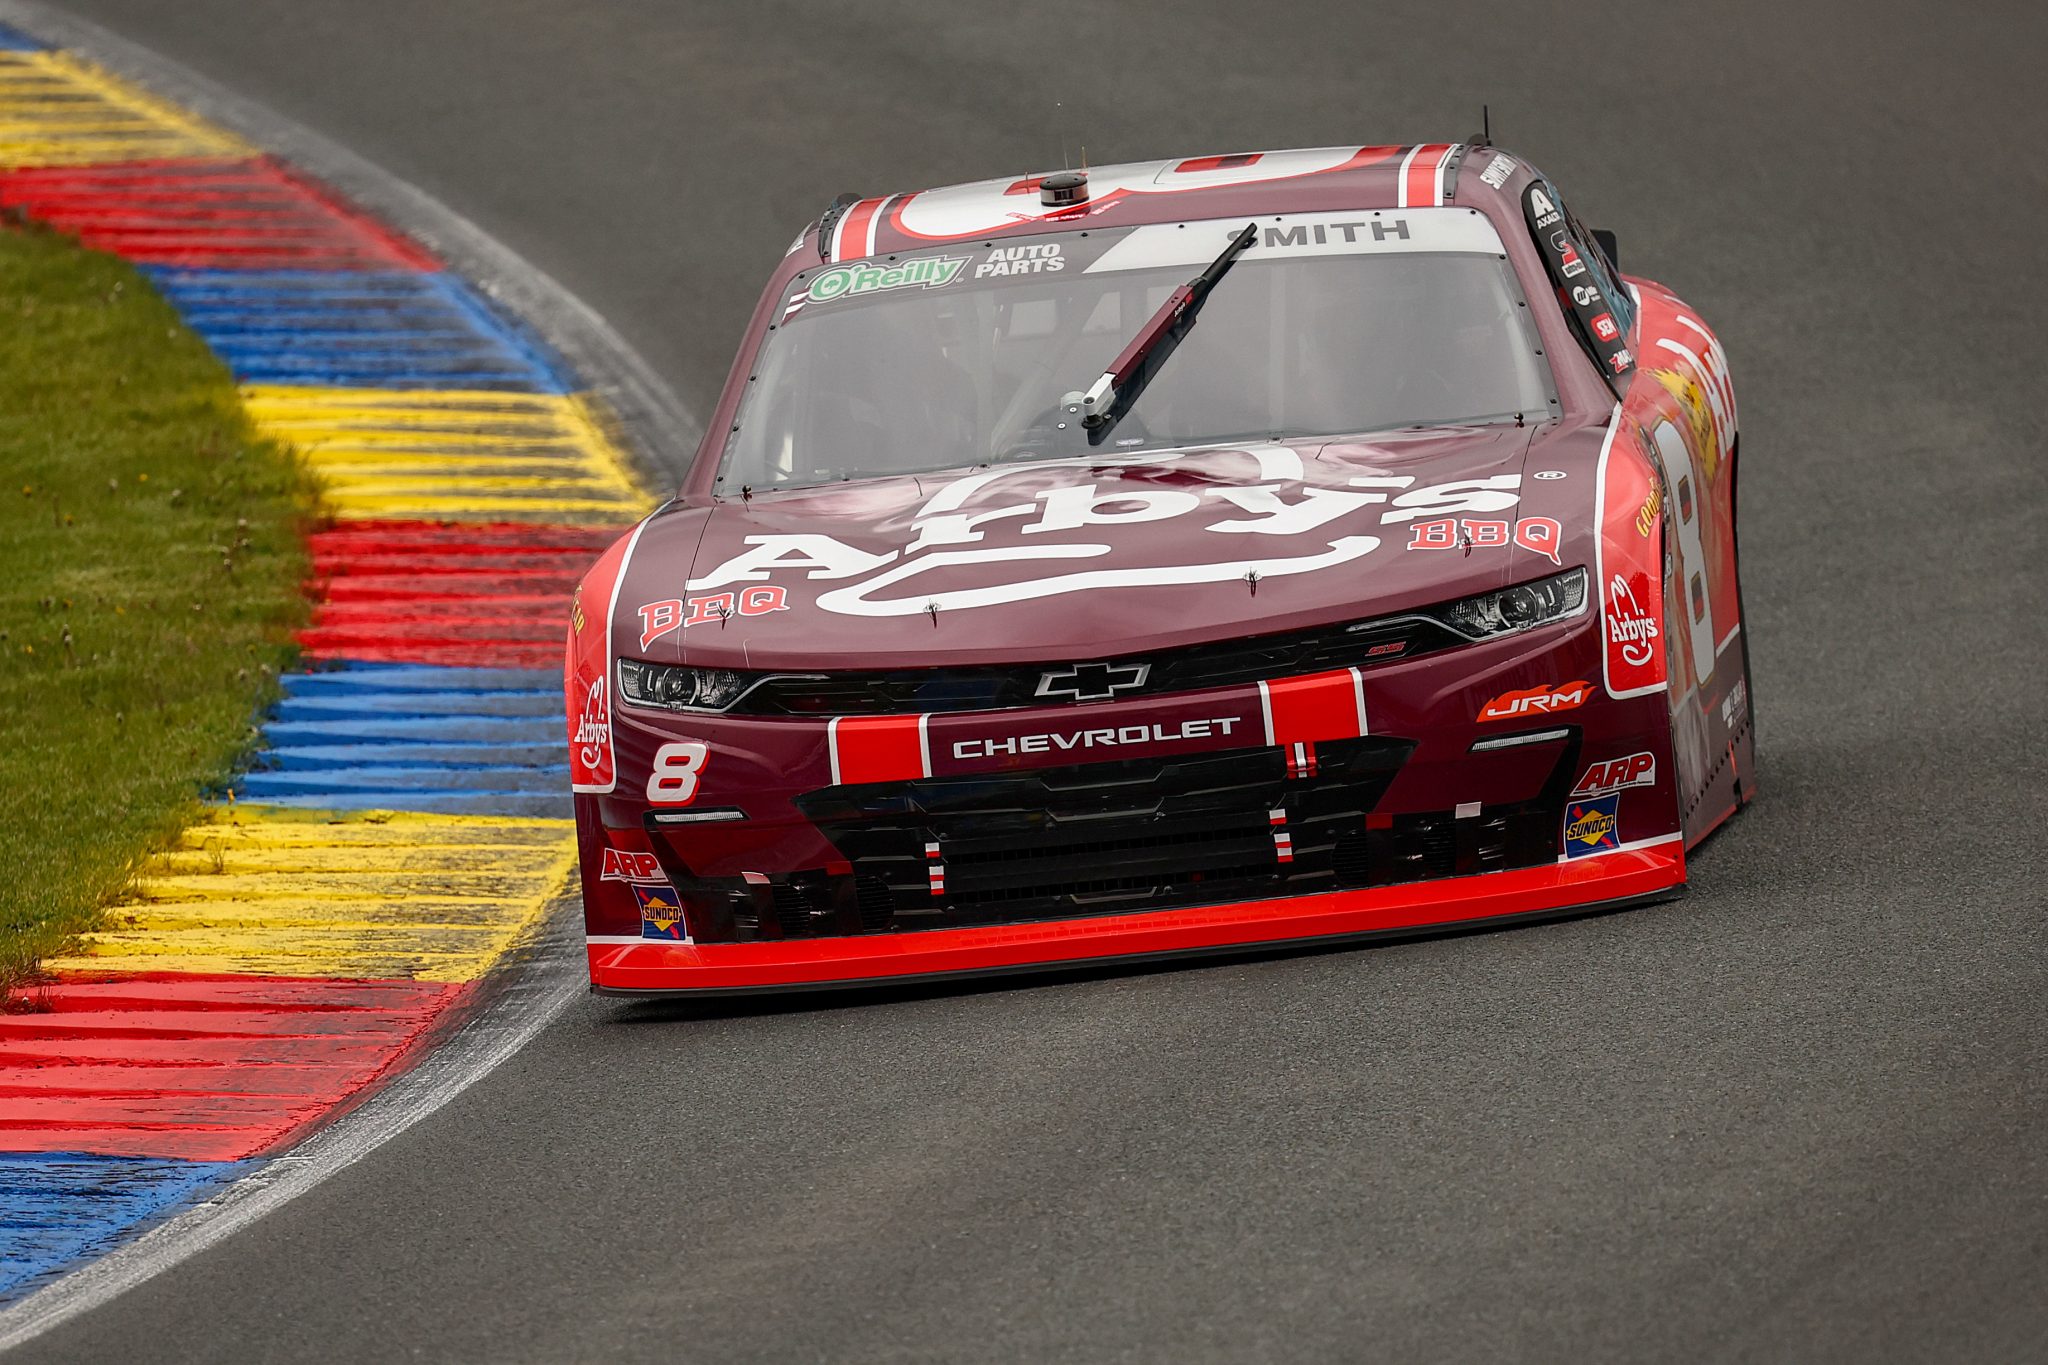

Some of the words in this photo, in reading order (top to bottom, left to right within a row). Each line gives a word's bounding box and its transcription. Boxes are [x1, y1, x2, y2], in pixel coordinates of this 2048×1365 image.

[1536, 211, 1561, 230] AXAL
[974, 255, 1066, 279] PARTS
[986, 243, 1061, 264] AUTO
[808, 259, 962, 301] O'Reilly
[685, 472, 1522, 591] Arby's
[1407, 517, 1562, 566] BBQ
[637, 586, 790, 653] BBQ
[1608, 611, 1659, 647] Arby's
[1486, 690, 1582, 717] JRM
[573, 713, 608, 752] Arby's
[952, 717, 1241, 759] CHEVROLET
[646, 742, 712, 807] 8
[1575, 754, 1654, 791] ARP
[1568, 815, 1613, 840] SUNOCO
[604, 850, 658, 878] ARP
[644, 906, 680, 921] SUNOCO
